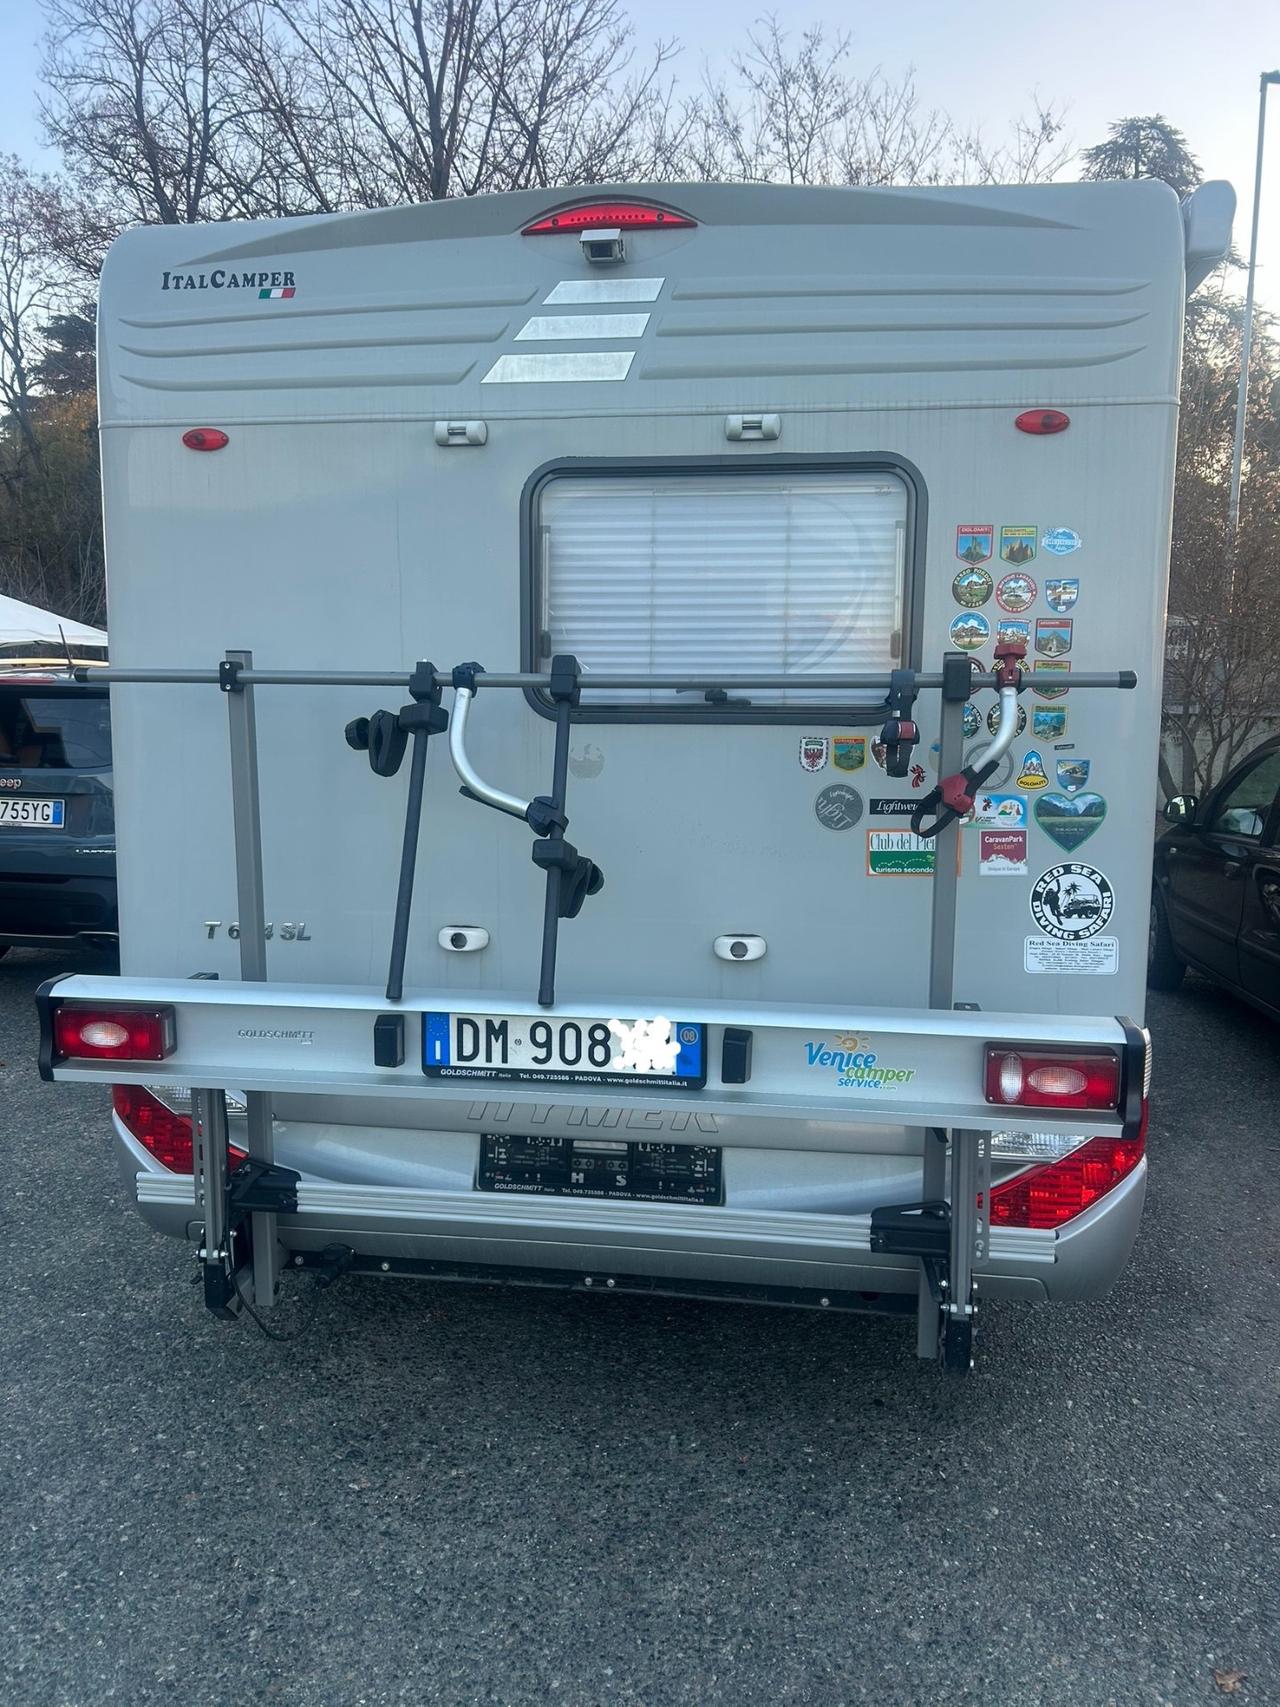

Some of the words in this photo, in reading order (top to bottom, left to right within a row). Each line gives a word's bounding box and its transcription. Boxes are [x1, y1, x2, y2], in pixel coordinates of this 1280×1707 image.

[0, 801, 50, 821] 755YG
[870, 833, 893, 850] Club
[897, 833, 912, 850] del
[984, 835, 1024, 843] CaravanPark
[875, 866, 902, 874] turismo
[903, 866, 934, 874] secondo
[1036, 866, 1065, 893] RED
[1070, 864, 1103, 886] SEA
[1032, 900, 1075, 940] DIVING
[1078, 891, 1112, 939] SAFARI
[204, 921, 222, 940] T
[280, 922, 312, 941] SL
[238, 1029, 315, 1039] GOLDSCHMITT
[456, 1018, 509, 1064] DM
[804, 1042, 877, 1073] Venice
[440, 1068, 497, 1077] GOLDSCHMITT
[574, 1075, 601, 1083] PADOVA
[846, 1066, 915, 1083] camper
